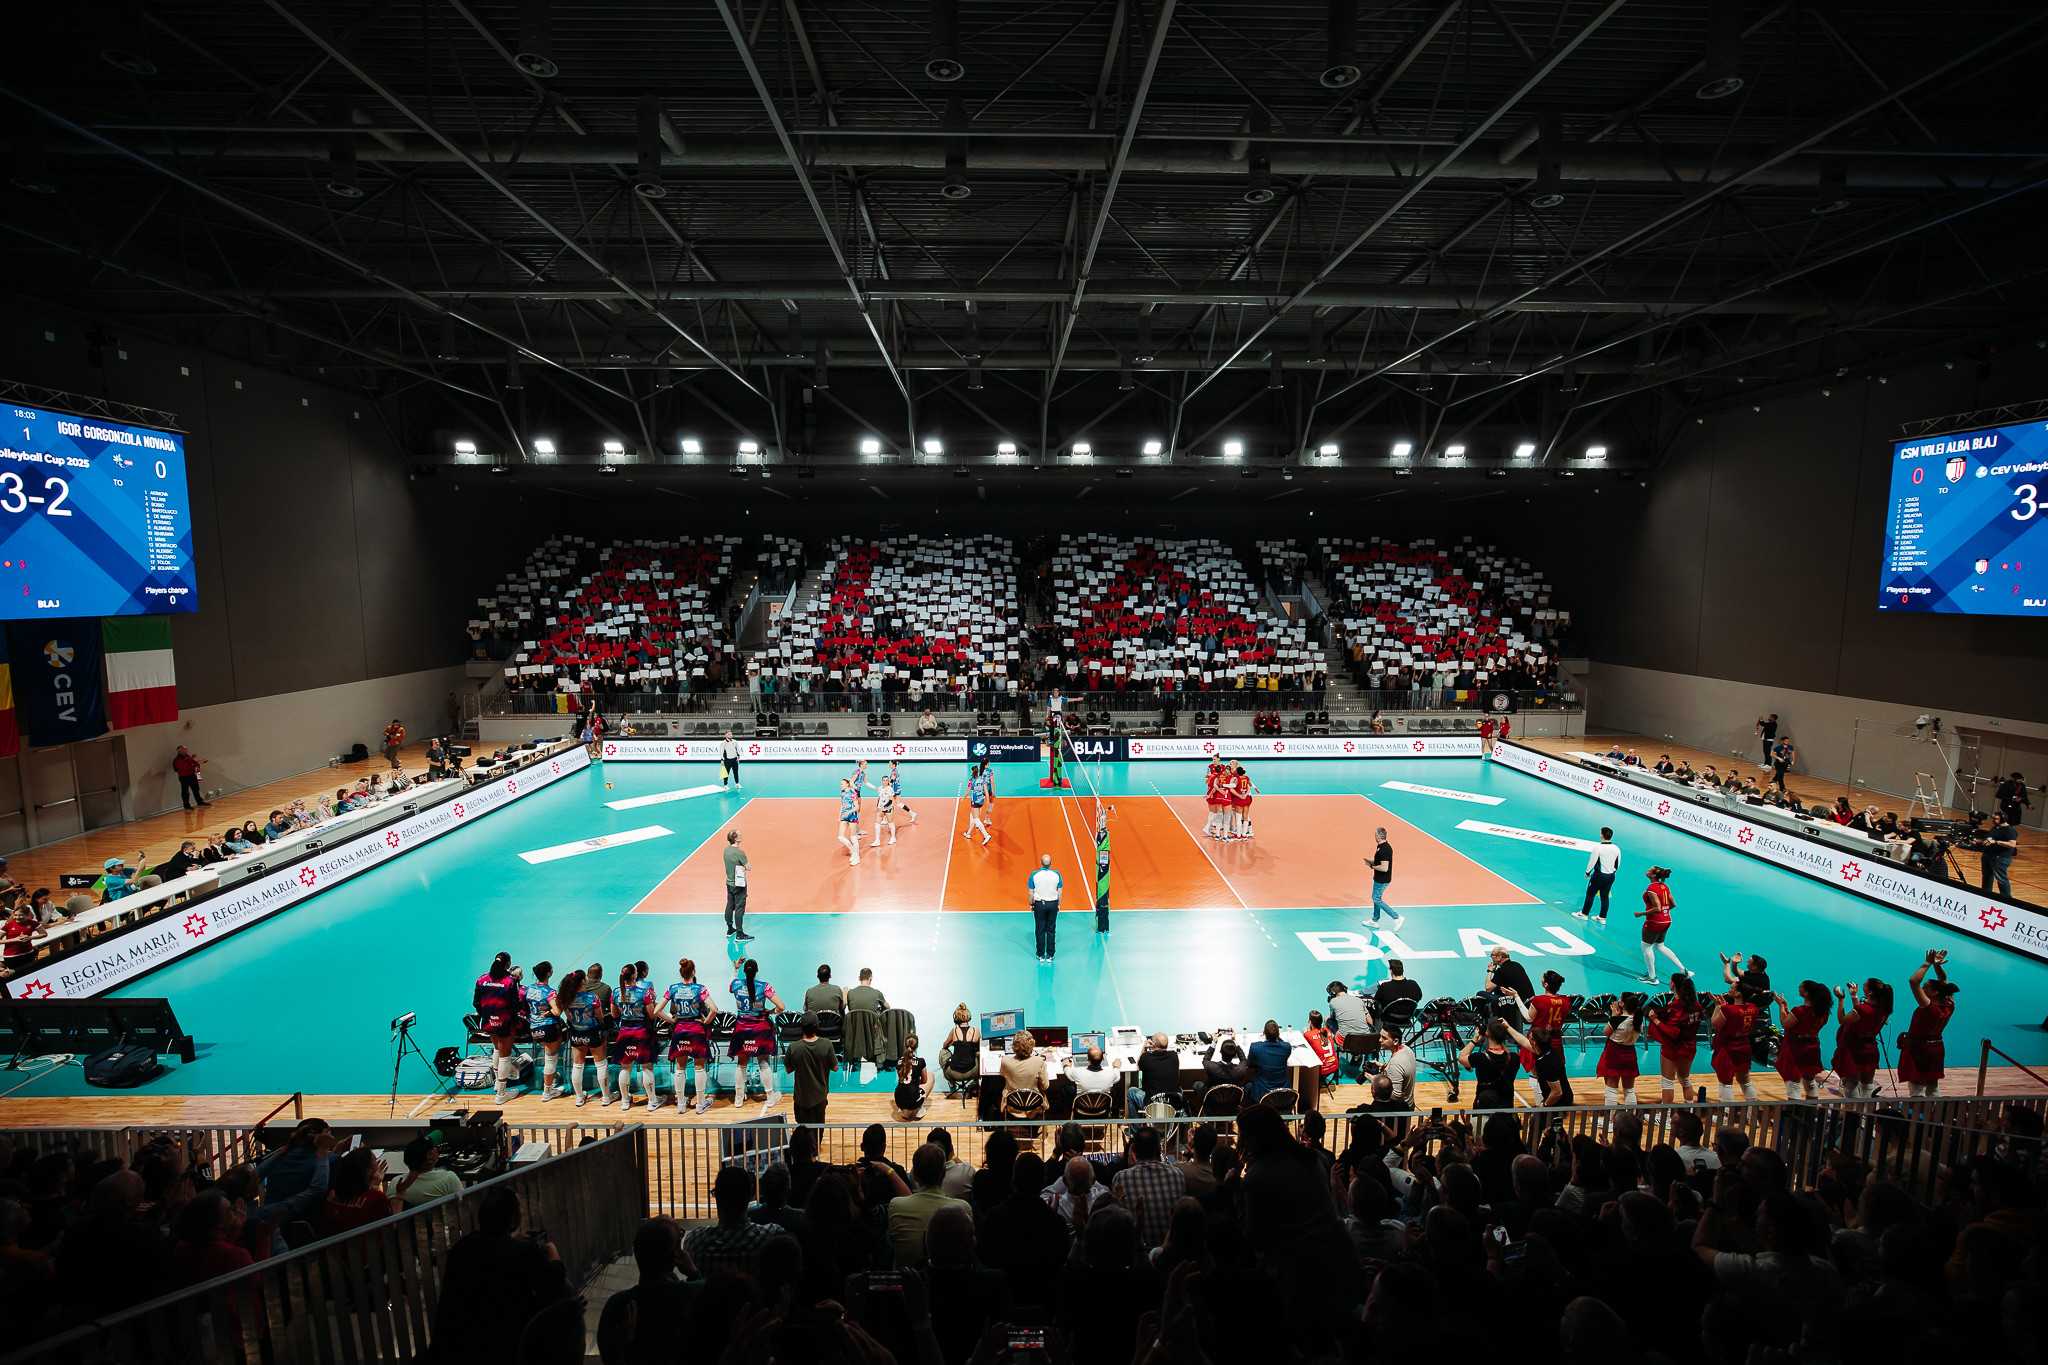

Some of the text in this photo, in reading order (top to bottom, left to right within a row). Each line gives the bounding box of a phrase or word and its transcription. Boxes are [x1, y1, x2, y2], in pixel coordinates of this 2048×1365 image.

[14, 409, 36, 420] 18:03
[23, 427, 31, 441] 1
[57, 420, 176, 453] IGOR GORGONZOLA NOVARA
[1900, 435, 1998, 460] CSM VOLEI ALBA BLAJ
[44, 454, 66, 467] Cup
[66, 457, 91, 468] 2025
[155, 460, 167, 479] 0
[1912, 468, 1924, 485] 0
[1990, 465, 2012, 476] CEV
[113, 478, 124, 487] TO
[0, 472, 73, 517] 3-2
[19, 560, 26, 569] 3
[2015, 562, 2022, 571] 3
[23, 586, 30, 595] 2
[145, 587, 189, 596] Players change
[1886, 586, 1932, 595] Players change
[2012, 585, 2020, 594] 2
[38, 600, 60, 609] BLAJ
[170, 595, 177, 605] 0
[1902, 595, 1909, 604] 0
[2023, 599, 2047, 607] BLAJ
[54, 674, 77, 722] CEV
[1075, 741, 1114, 756] BLAJ
[1549, 765, 1590, 786] REGINA MARIA
[466, 788, 506, 811] REGINA MARIA
[1606, 785, 1630, 800] REGINA
[1632, 794, 1653, 808] MARIA
[401, 820, 430, 839] REGINA
[430, 812, 452, 827] MARIA
[1673, 808, 1703, 825] REGINA
[1705, 819, 1732, 835] MARIA
[319, 854, 355, 875] REGINA
[356, 842, 383, 859] MARIA
[1757, 836, 1833, 870] REGINA MARIA
[1866, 872, 1968, 915] REGINA MARIA
[212, 879, 298, 923] REGINA MARIA
[1295, 926, 1597, 962] BLAJ
[60, 931, 177, 989] REGINA MARIA
[623, 1004, 633, 1017] 24
[680, 1001, 690, 1014] 16
[744, 998, 750, 1011] 3
[574, 1010, 580, 1023] 6
[1548, 1007, 1562, 1024] 14
